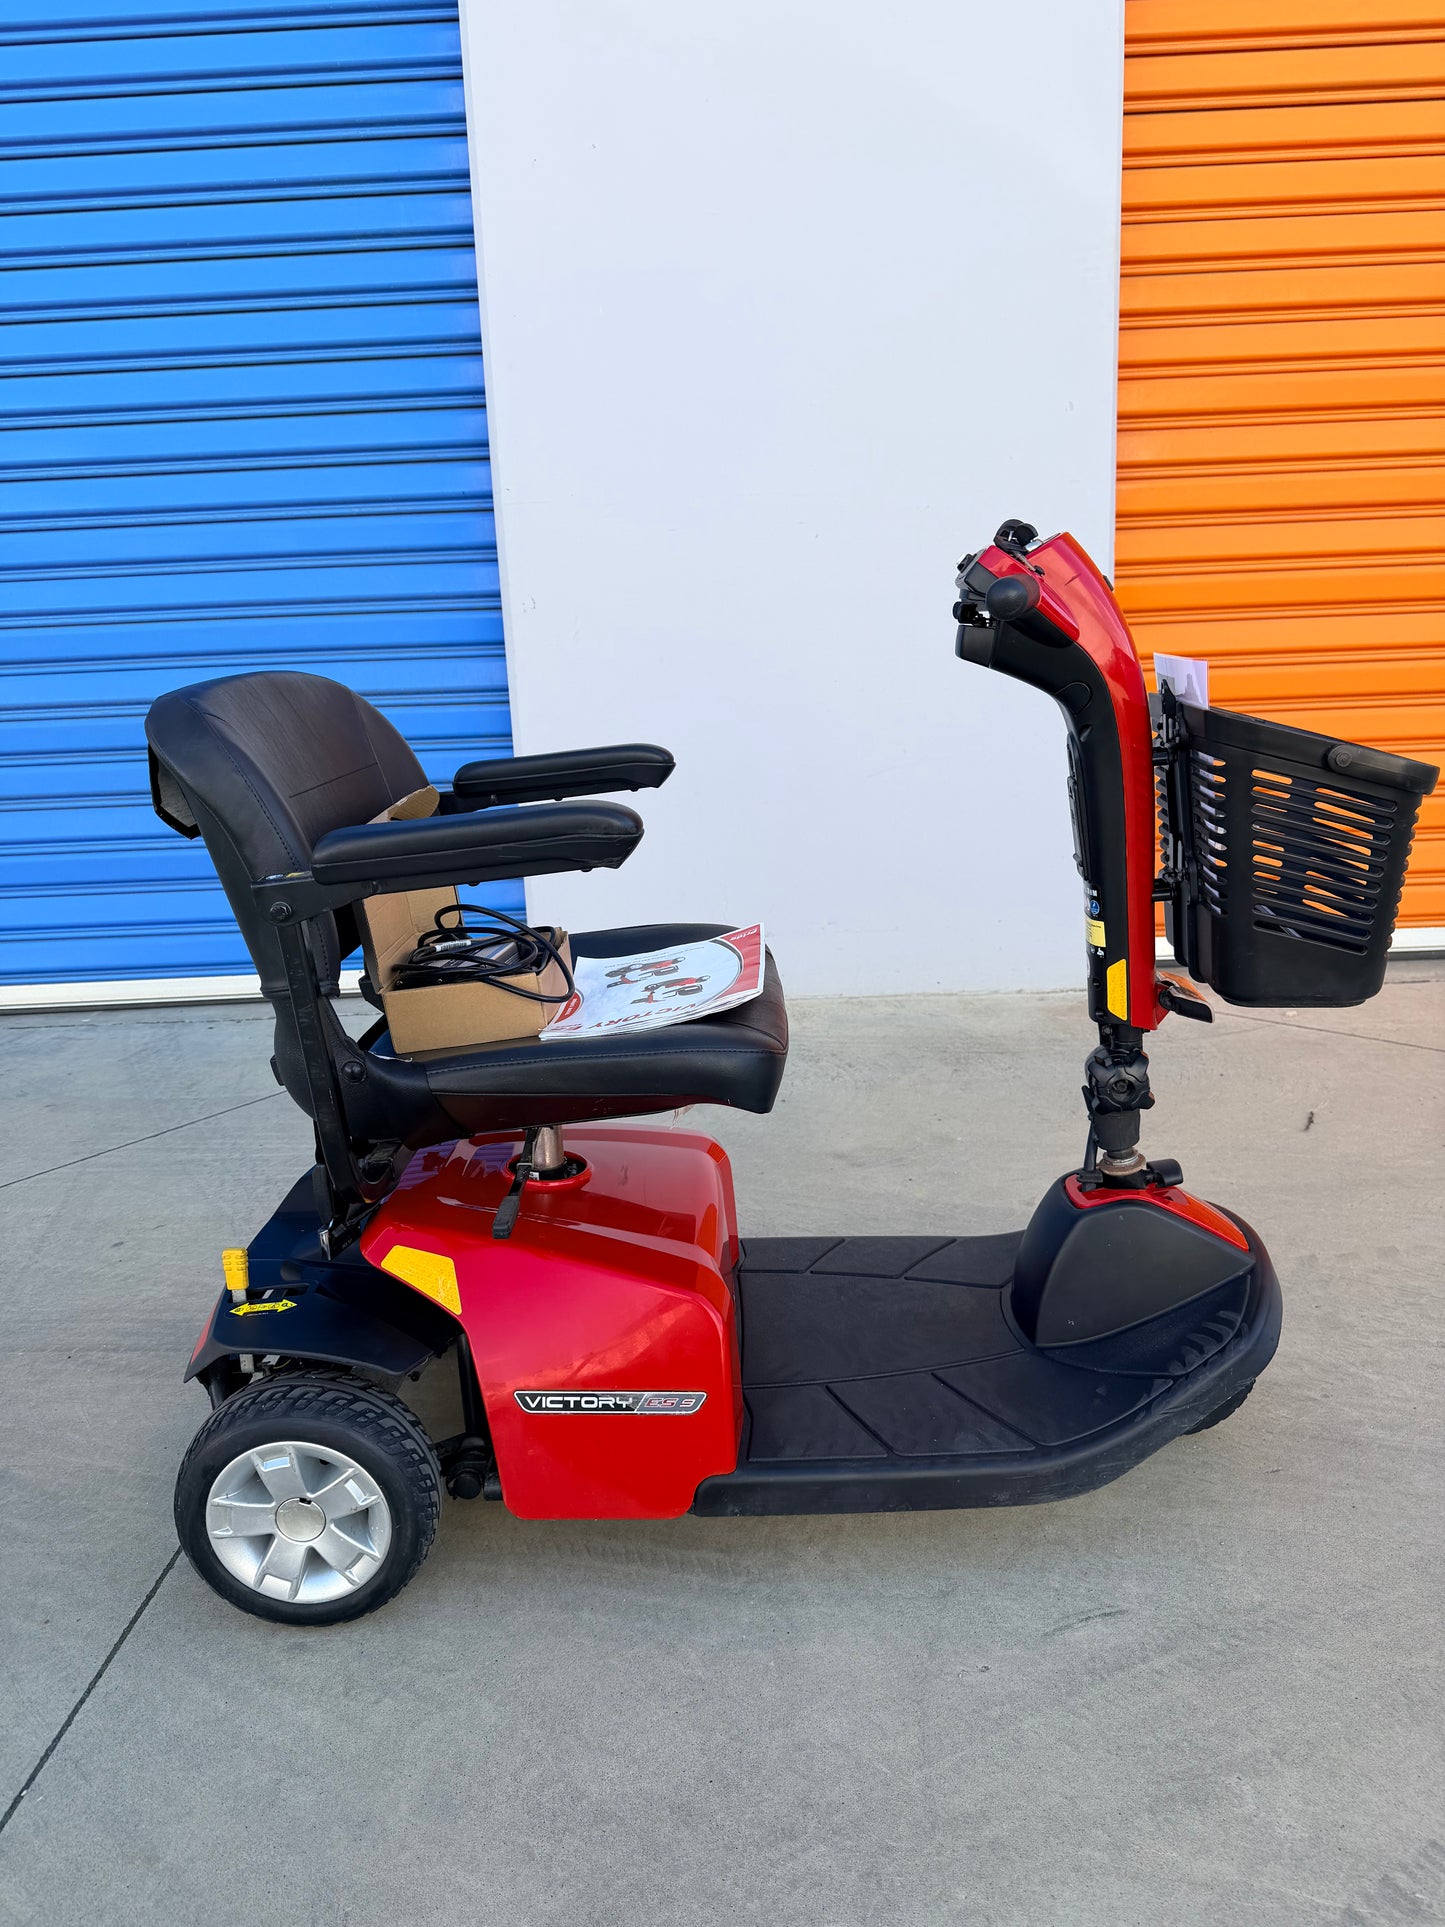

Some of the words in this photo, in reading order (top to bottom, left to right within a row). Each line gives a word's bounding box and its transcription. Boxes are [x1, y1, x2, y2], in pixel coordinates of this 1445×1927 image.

[587, 1003, 696, 1030] VICTORY
[524, 1395, 635, 1409] VICTORY
[645, 1397, 678, 1408] ES
[679, 1397, 696, 1408] 9
